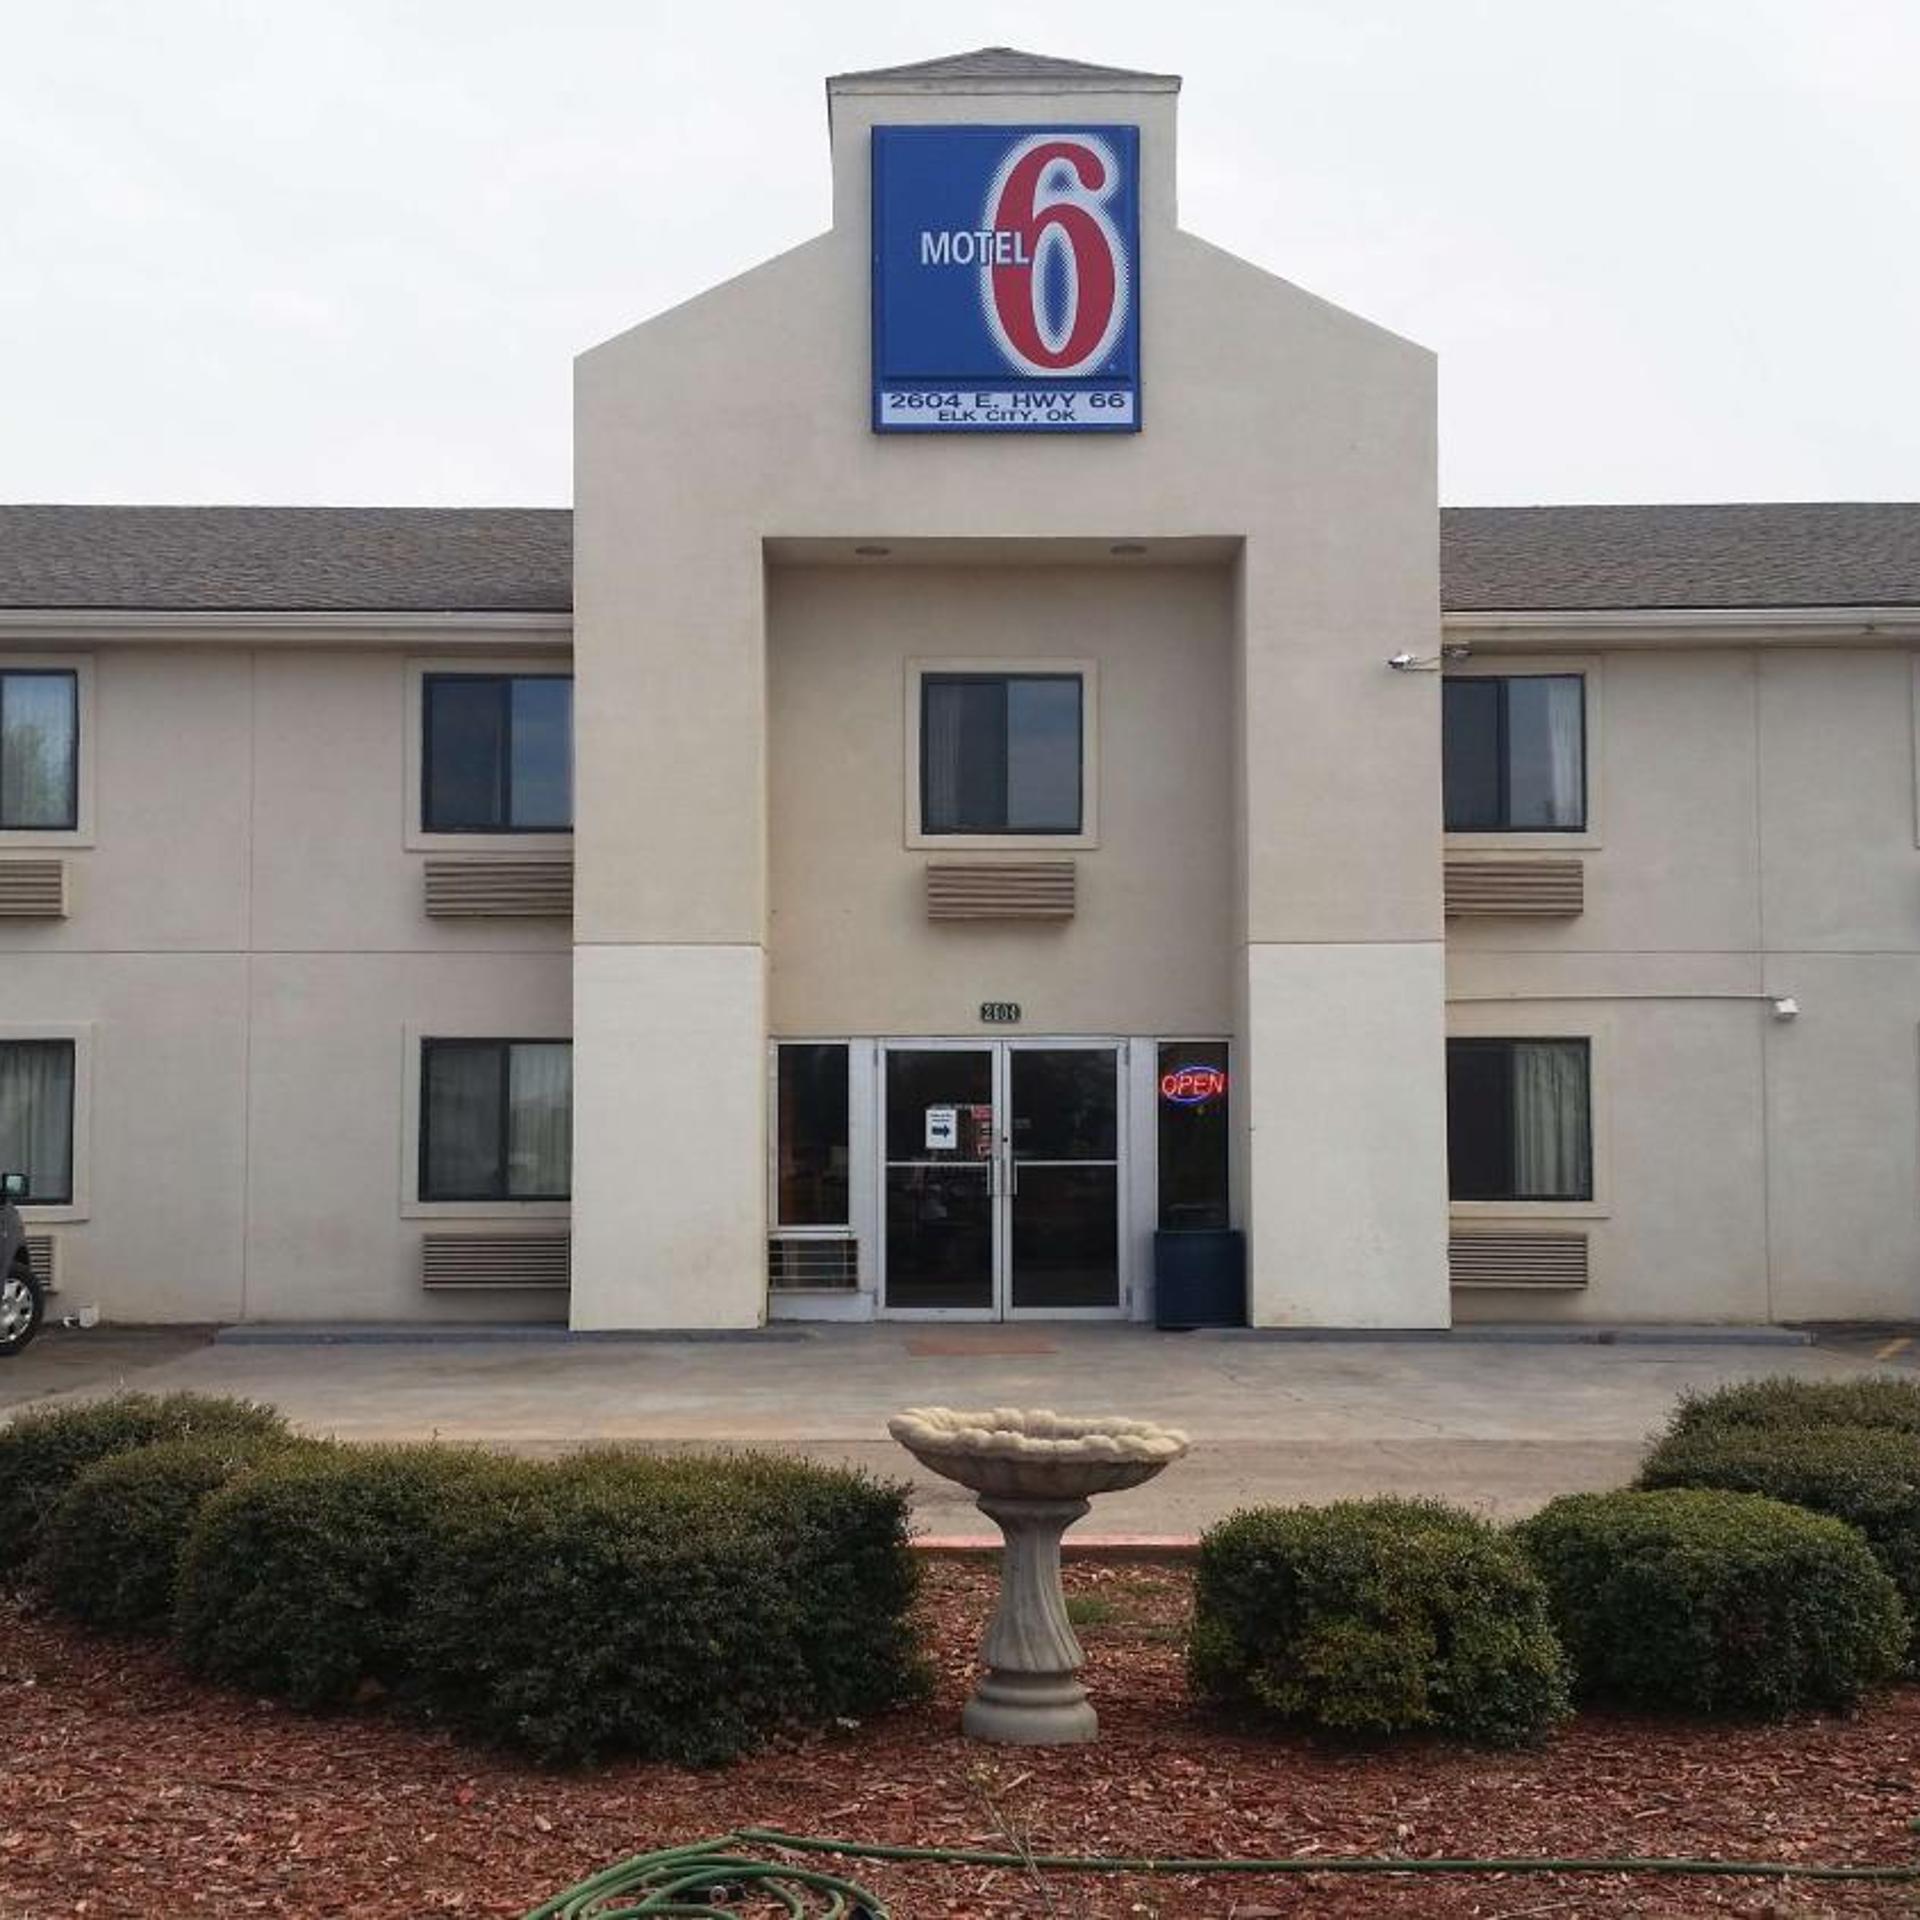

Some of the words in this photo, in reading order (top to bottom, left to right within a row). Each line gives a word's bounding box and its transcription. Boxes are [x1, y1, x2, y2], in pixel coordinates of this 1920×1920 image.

[920, 231, 1031, 265] MOTEL
[990, 138, 1118, 371] 6
[889, 392, 962, 408] 2604
[975, 392, 999, 408] E.
[1012, 392, 1076, 408] HWY
[1089, 392, 1125, 408] 66
[938, 410, 976, 421] ELK
[1046, 409, 1076, 421] OK
[1161, 1073, 1225, 1096] OPEN
